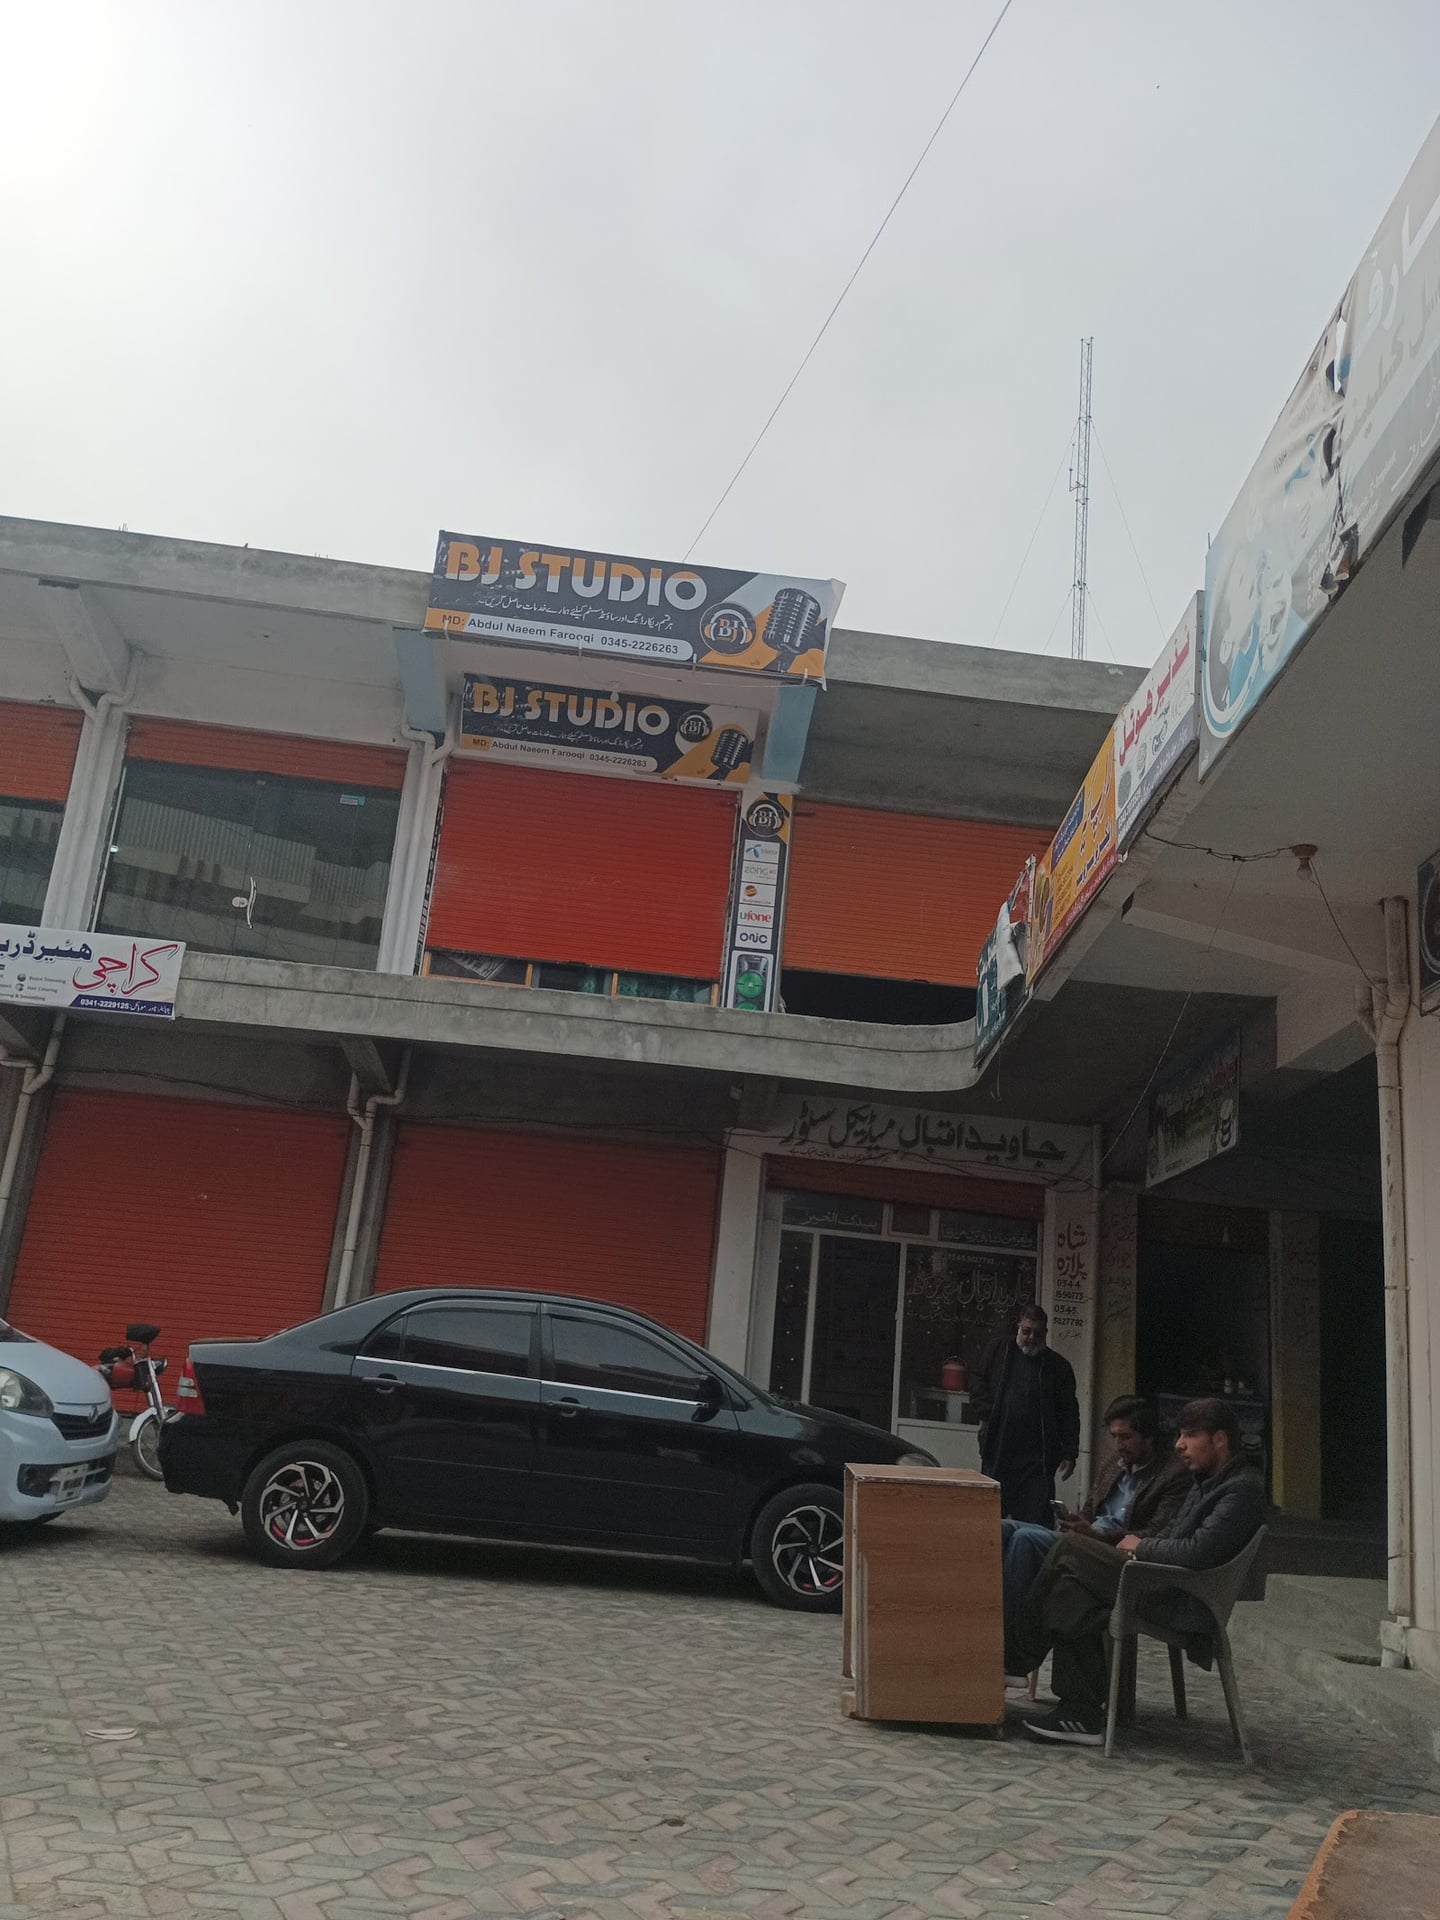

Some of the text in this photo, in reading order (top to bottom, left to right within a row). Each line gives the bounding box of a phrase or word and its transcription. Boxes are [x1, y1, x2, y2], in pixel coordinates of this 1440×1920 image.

[446, 541, 708, 611] BJ STUDIO
[442, 614, 679, 655] MD: Abdul Naeem Farooqi 0345-2226263
[472, 682, 670, 735] BJ STUDIO
[472, 738, 647, 768] MD: Abdul Naeem Farooqi 0345-2226263
[739, 910, 772, 923] ufone
[739, 932, 768, 944] onic
[73, 943, 179, 995] کراچی
[898, 1113, 965, 1154] اقبال
[965, 1125, 1066, 1168] جاوید
[1057, 1222, 1087, 1250] شاہ
[1057, 1252, 1088, 1280] پلازہ
